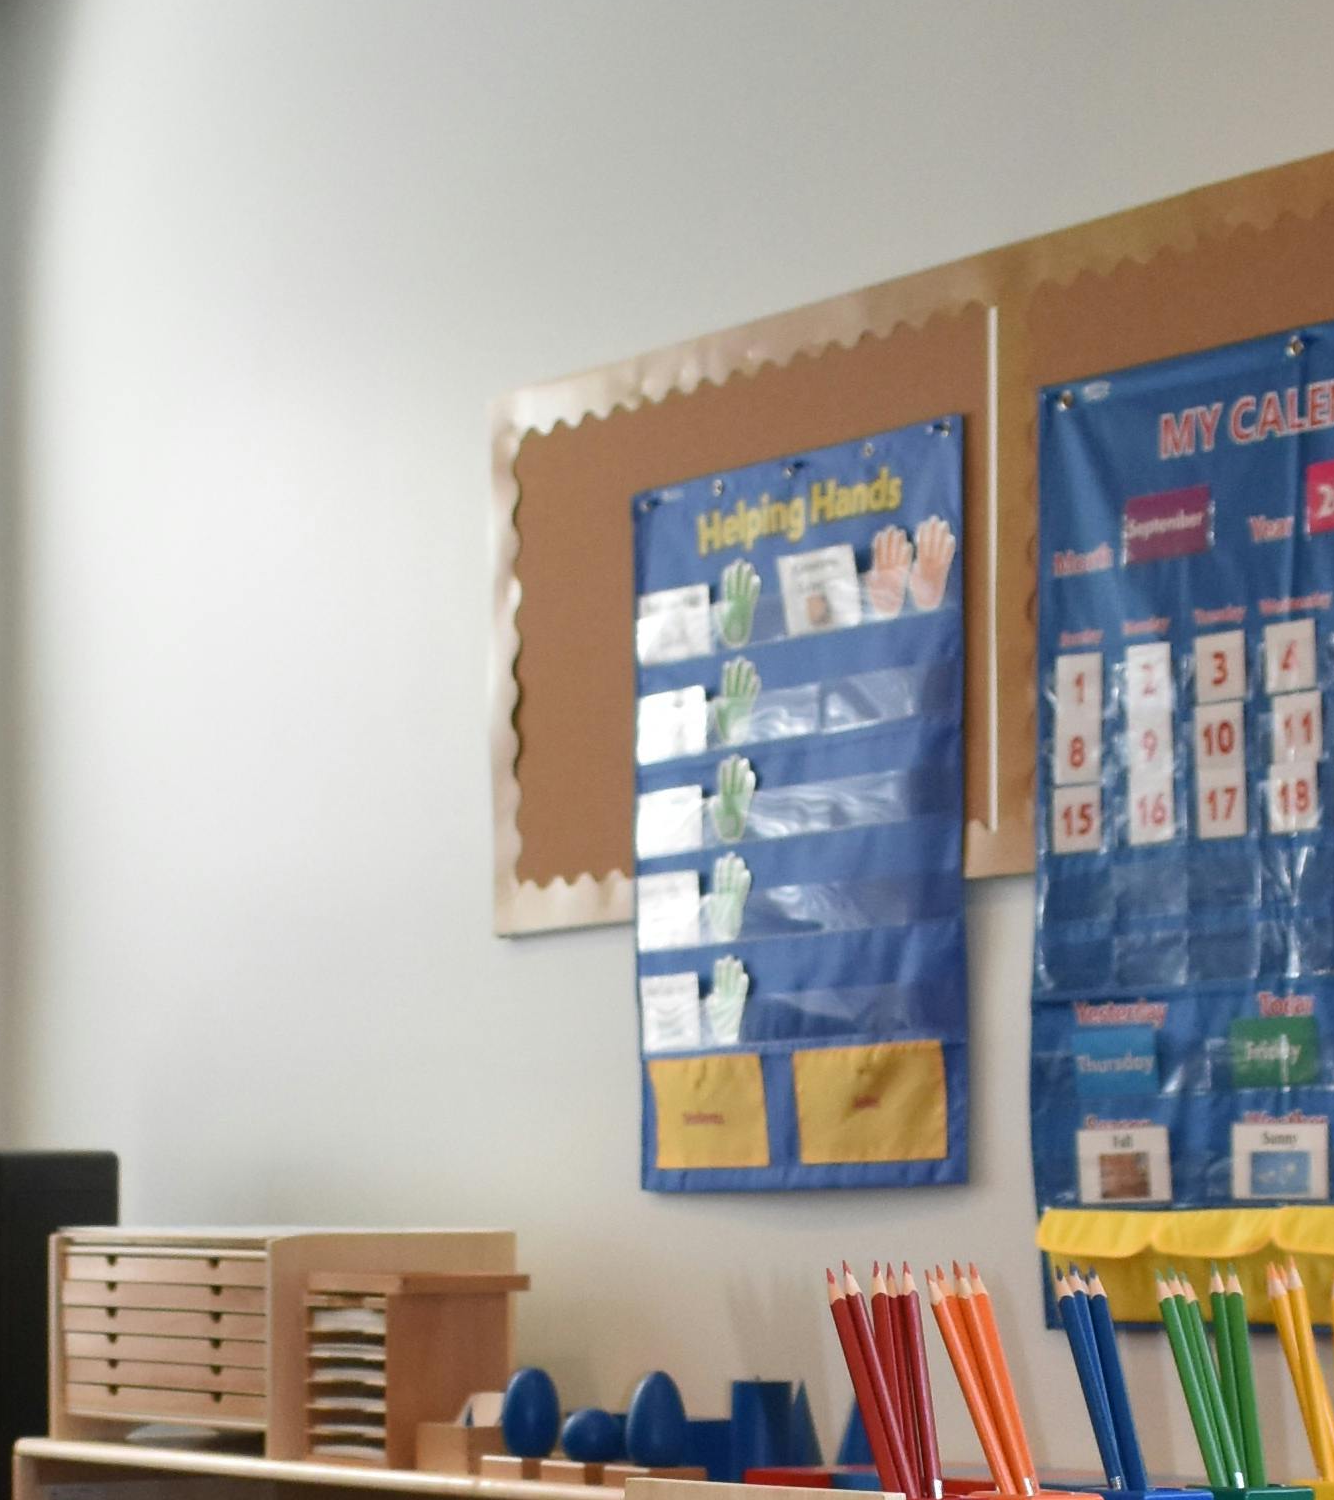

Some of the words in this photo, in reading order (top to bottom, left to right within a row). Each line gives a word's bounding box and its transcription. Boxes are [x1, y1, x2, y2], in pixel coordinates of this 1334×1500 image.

[1160, 403, 1222, 460] MY
[696, 493, 805, 557] Helping
[810, 466, 902, 525] Hands
[1126, 508, 1204, 541] September
[1249, 516, 1294, 543] Year
[1074, 671, 1086, 705] 1
[1212, 651, 1228, 686] 3
[1070, 736, 1085, 769] 8
[1142, 729, 1158, 763] 9
[1202, 719, 1235, 757] 10
[1284, 711, 1312, 746] 11
[1061, 803, 1093, 837] 15
[1138, 793, 1166, 827] 16
[1207, 786, 1237, 821] 17
[1279, 779, 1311, 815] 18
[1074, 998, 1168, 1029] Yesterday
[1076, 1052, 1155, 1074] Thursday
